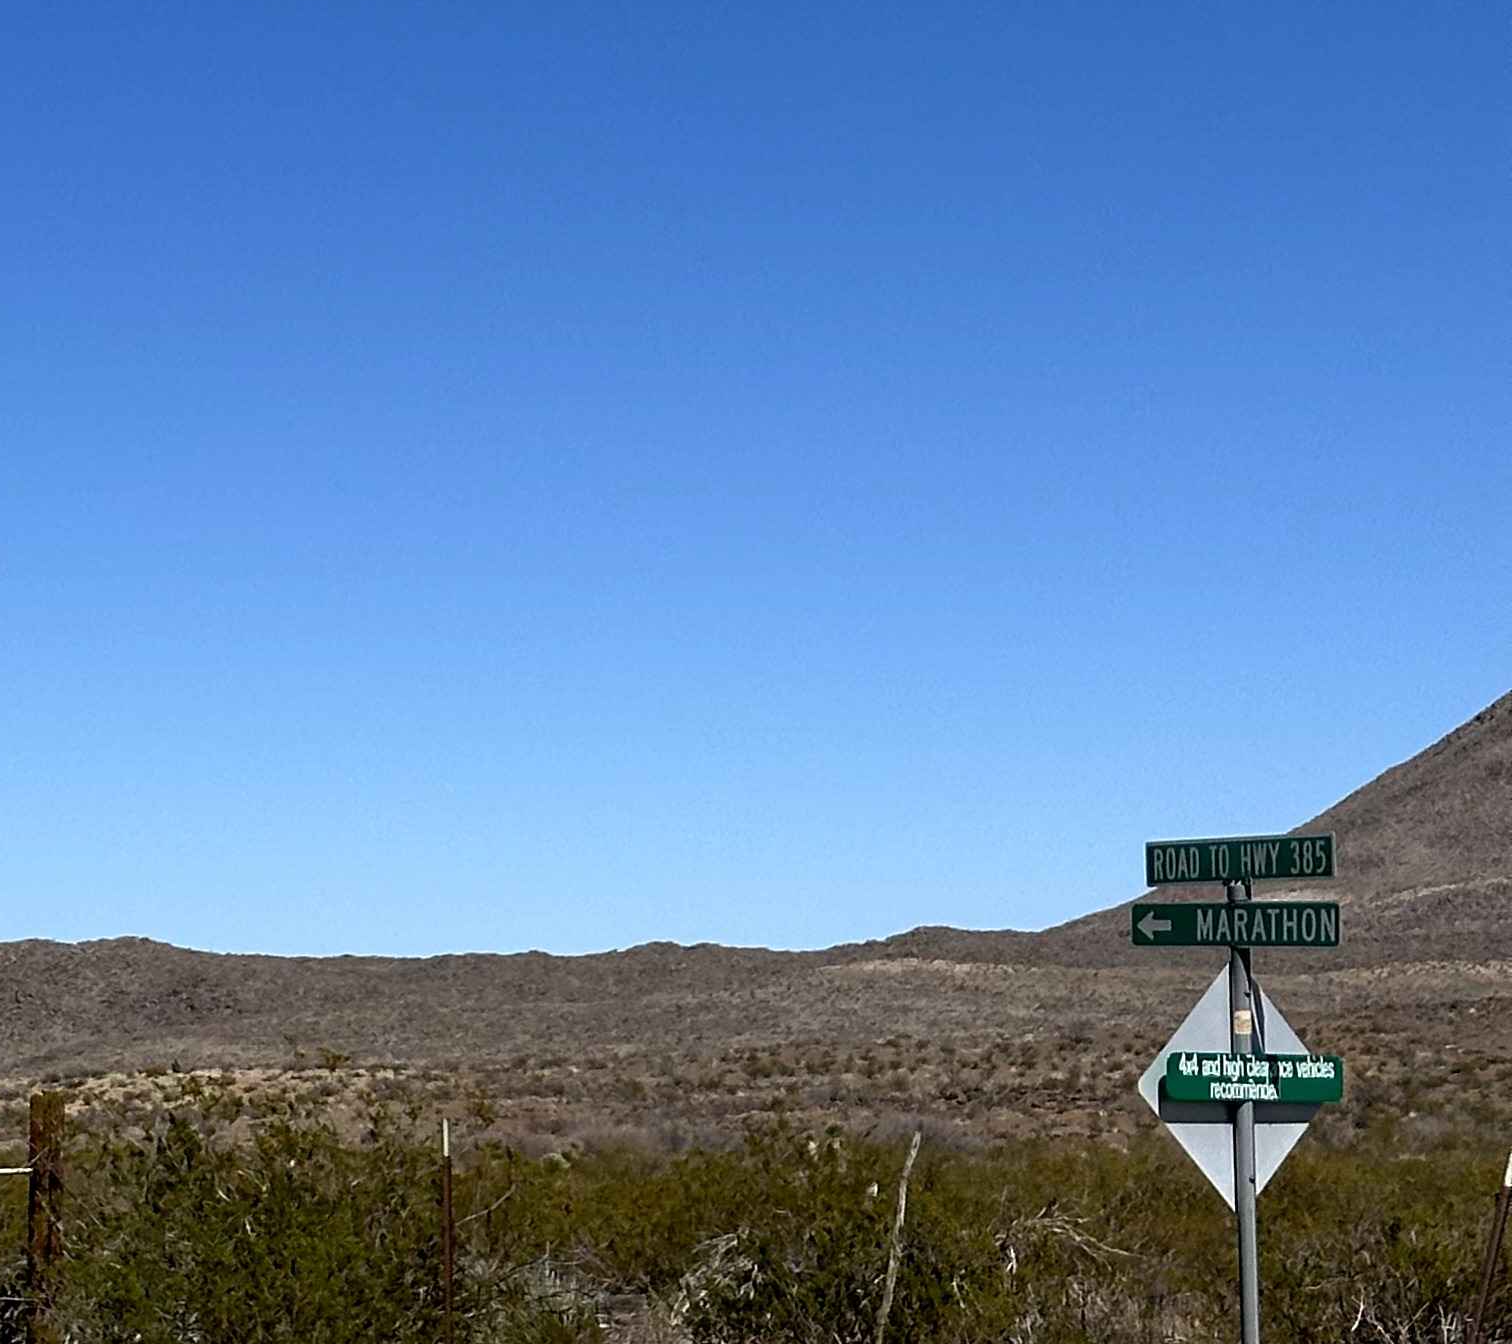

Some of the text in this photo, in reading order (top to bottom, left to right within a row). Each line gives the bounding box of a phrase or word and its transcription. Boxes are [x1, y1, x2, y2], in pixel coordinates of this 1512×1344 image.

[1154, 840, 1326, 881] ROAD TO HWY 385
[1196, 908, 1336, 942] MARATHON
[1179, 1053, 1199, 1075] 4x4
[1202, 1054, 1221, 1076] and
[1223, 1054, 1245, 1081] high
[1296, 1056, 1335, 1079] vehicles
